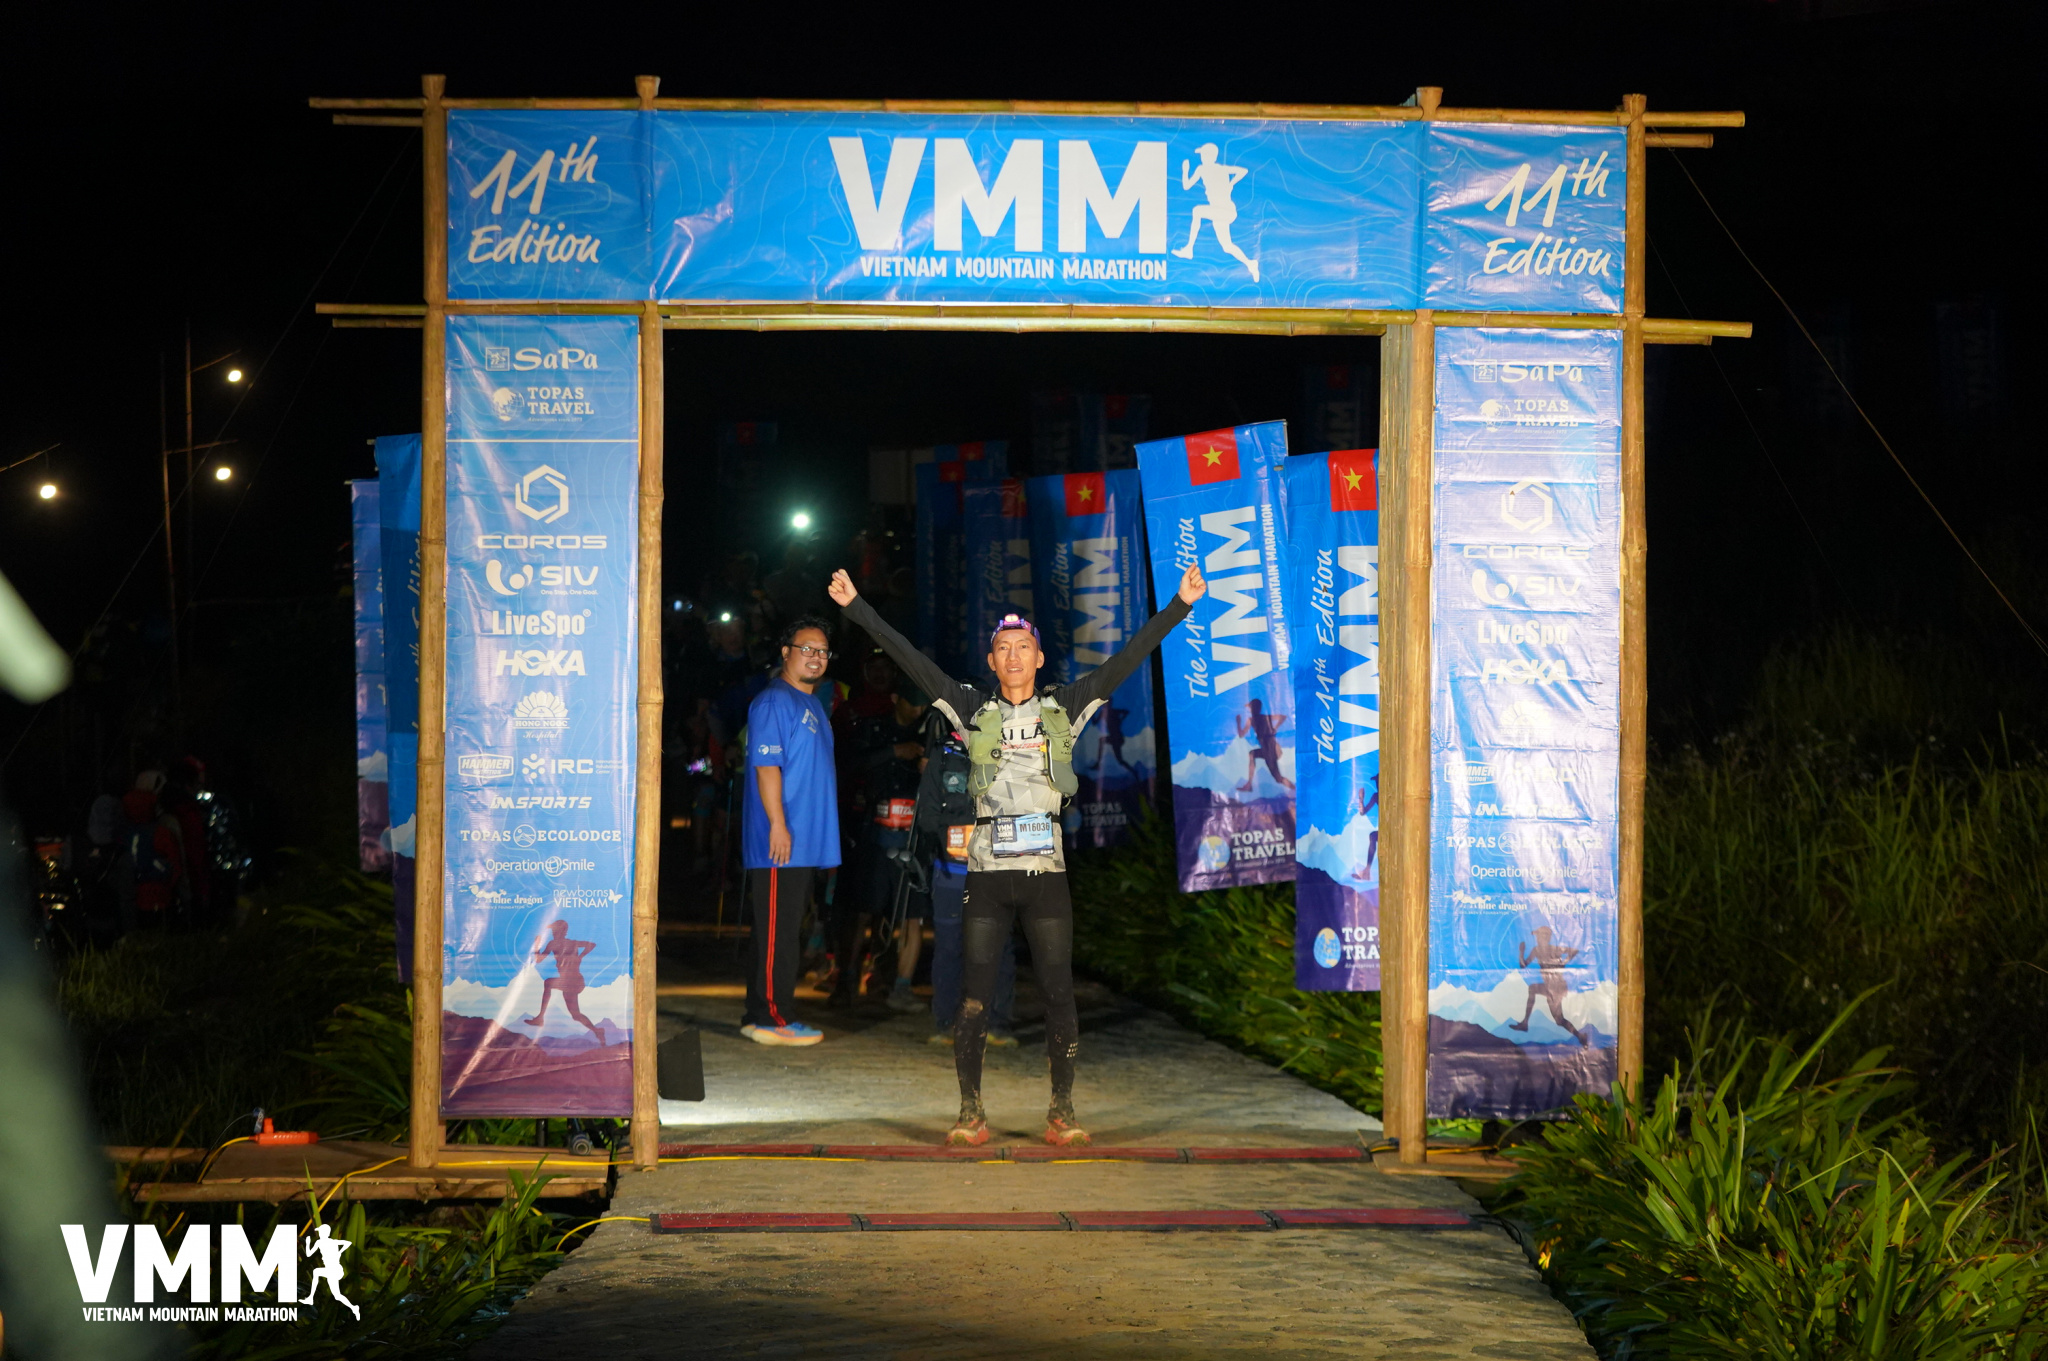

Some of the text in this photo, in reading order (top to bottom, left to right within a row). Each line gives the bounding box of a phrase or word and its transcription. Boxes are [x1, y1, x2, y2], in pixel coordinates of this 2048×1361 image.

[469, 135, 597, 215] 11th
[828, 136, 1167, 255] VMM
[1485, 150, 1609, 227] 11th
[467, 219, 600, 264] Edition
[1483, 232, 1609, 277] Edition
[860, 256, 1167, 281] VIETNAM MOUNTAIN MARATHON
[513, 347, 599, 371] SaPa
[1500, 361, 1583, 383] SaPa
[528, 387, 584, 400] TOPAS
[528, 402, 594, 415] TRAVEL
[1514, 399, 1569, 412] TOPAS
[1514, 414, 1578, 427] TRAVEL
[1260, 504, 1277, 562] MARATHON
[477, 535, 607, 549] COROS
[1463, 545, 1589, 560] COROS
[541, 566, 599, 586] SIV
[1049, 541, 1068, 611] Edition
[1268, 563, 1284, 626] MOUNTAIN
[1525, 577, 1581, 596] SIV
[1200, 505, 1273, 696] VMM
[495, 650, 587, 676] HOKA
[1310, 549, 1335, 764] The 11th Edition
[1183, 657, 1209, 699] The
[1480, 659, 1568, 685] HOKA
[523, 730, 560, 741] Hospital
[462, 759, 510, 769] HAMMER
[551, 759, 593, 774] IRC
[460, 830, 621, 842] TOPAS ECOLODGE
[1019, 822, 1050, 833] M16036
[1231, 828, 1285, 847] TOPAS
[1232, 842, 1296, 861] TRAVEL
[486, 859, 595, 873] Operation Smile
[1471, 865, 1530, 880] Operation
[553, 885, 609, 898] newborns
[514, 894, 543, 907] dragon
[553, 898, 608, 908] VIETNAM
[1499, 901, 1528, 912] dragon
[1539, 903, 1591, 915] VIETNAM
[1342, 927, 1379, 942] TOP
[1343, 944, 1380, 960] TRA
